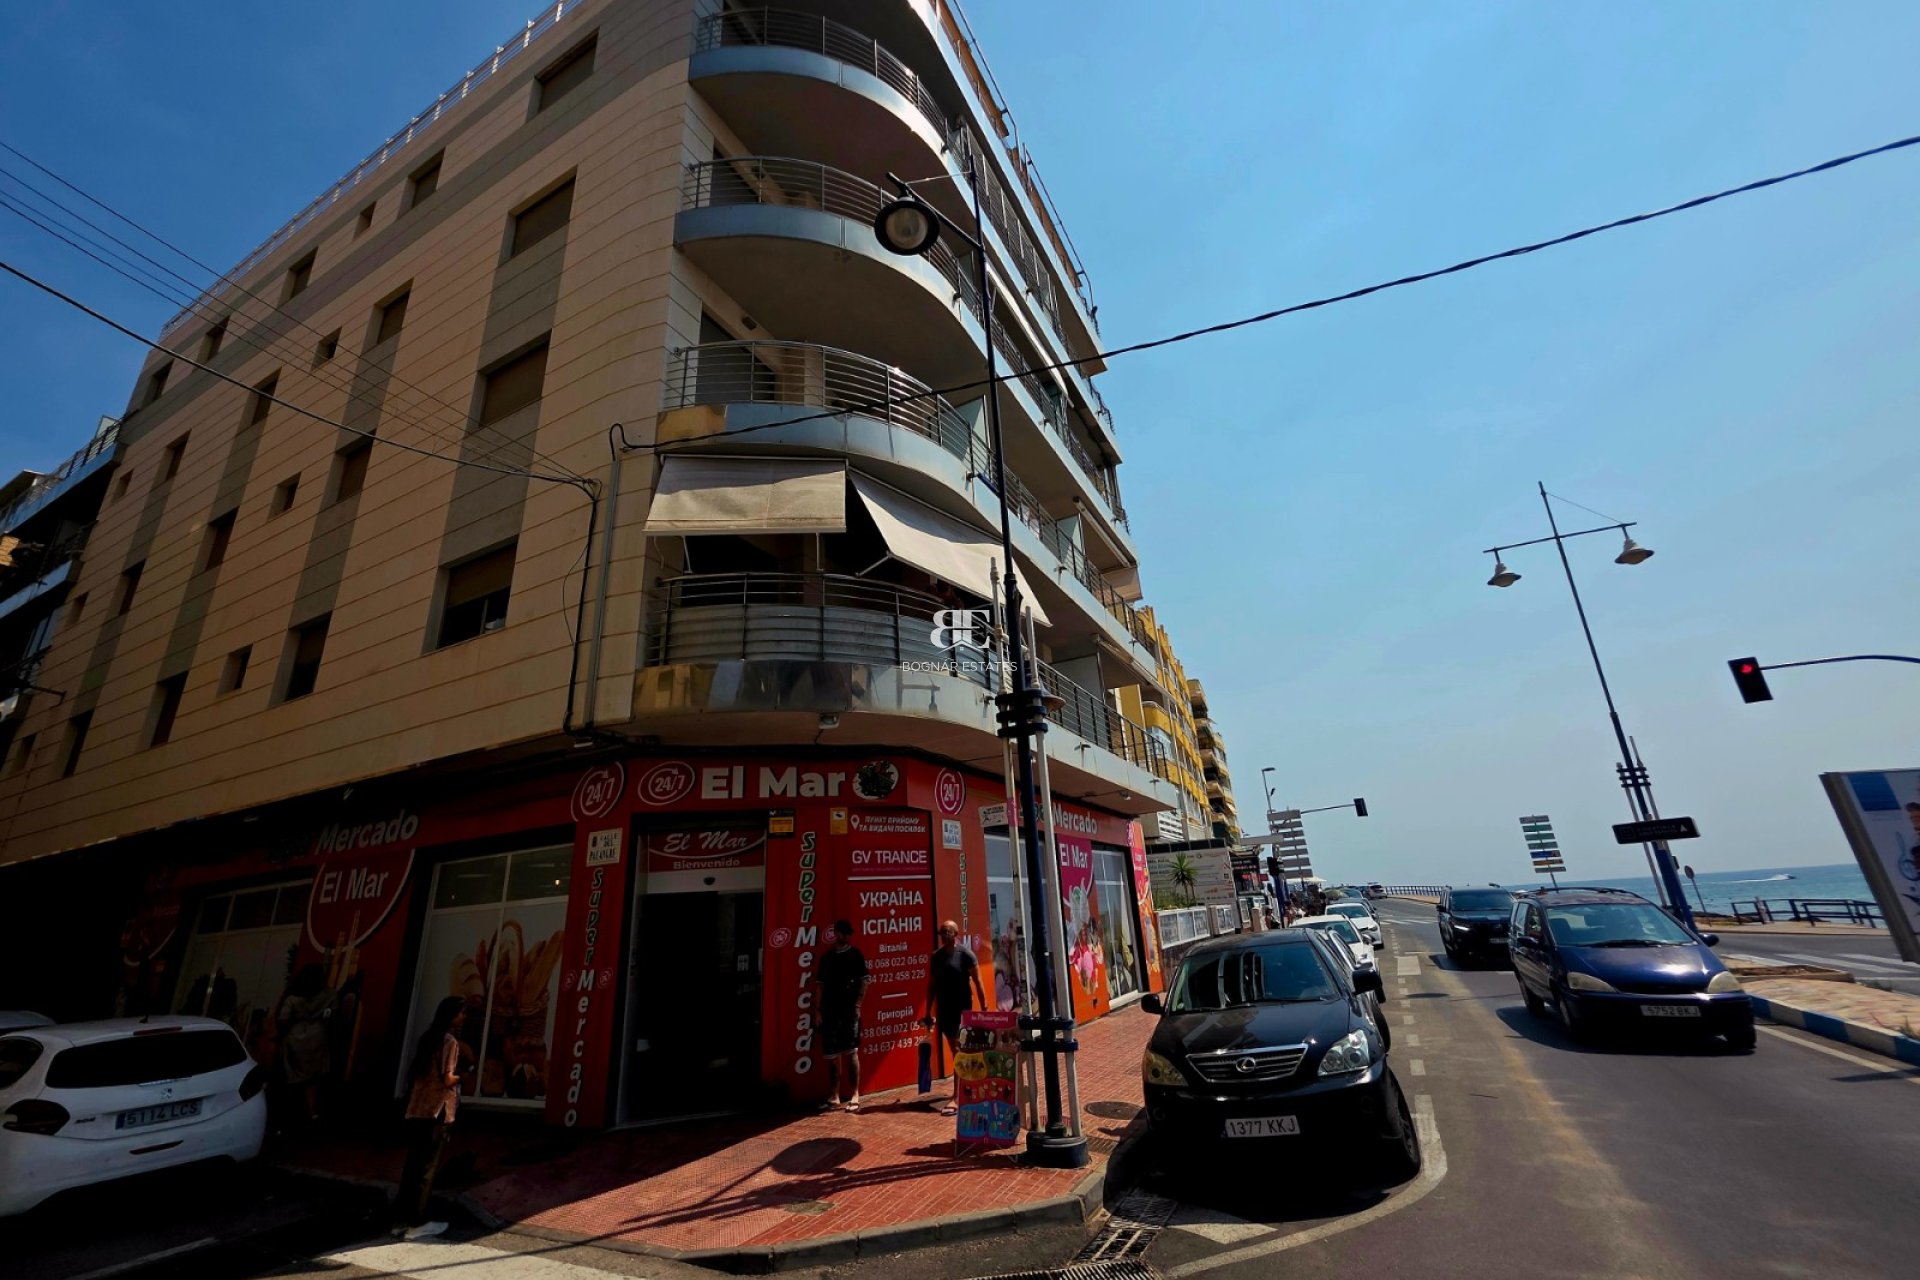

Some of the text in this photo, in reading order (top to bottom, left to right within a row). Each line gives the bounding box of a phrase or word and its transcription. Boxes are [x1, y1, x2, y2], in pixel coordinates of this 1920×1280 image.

[584, 776, 615, 808] 24/7
[653, 773, 686, 794] 24/7
[701, 765, 846, 800] El Mar
[943, 783, 960, 802] 24/7
[1051, 801, 1098, 835] Mercado
[314, 807, 419, 857] Mercado
[662, 829, 748, 854] El Mar
[672, 857, 741, 870] Bienvenido
[852, 850, 928, 864] GV TRANCE
[1059, 843, 1088, 869] El Mar
[319, 866, 390, 905] El Mar
[859, 887, 924, 908] УКРАЇНА
[863, 916, 923, 936] ІСПАНІЯ
[879, 941, 908, 953] Віталій
[891, 957, 906, 967] 022
[877, 1004, 914, 1022] Григорій
[126, 1102, 198, 1125] 5114 LCS
[1229, 1118, 1296, 1136] 1377 KKJ
